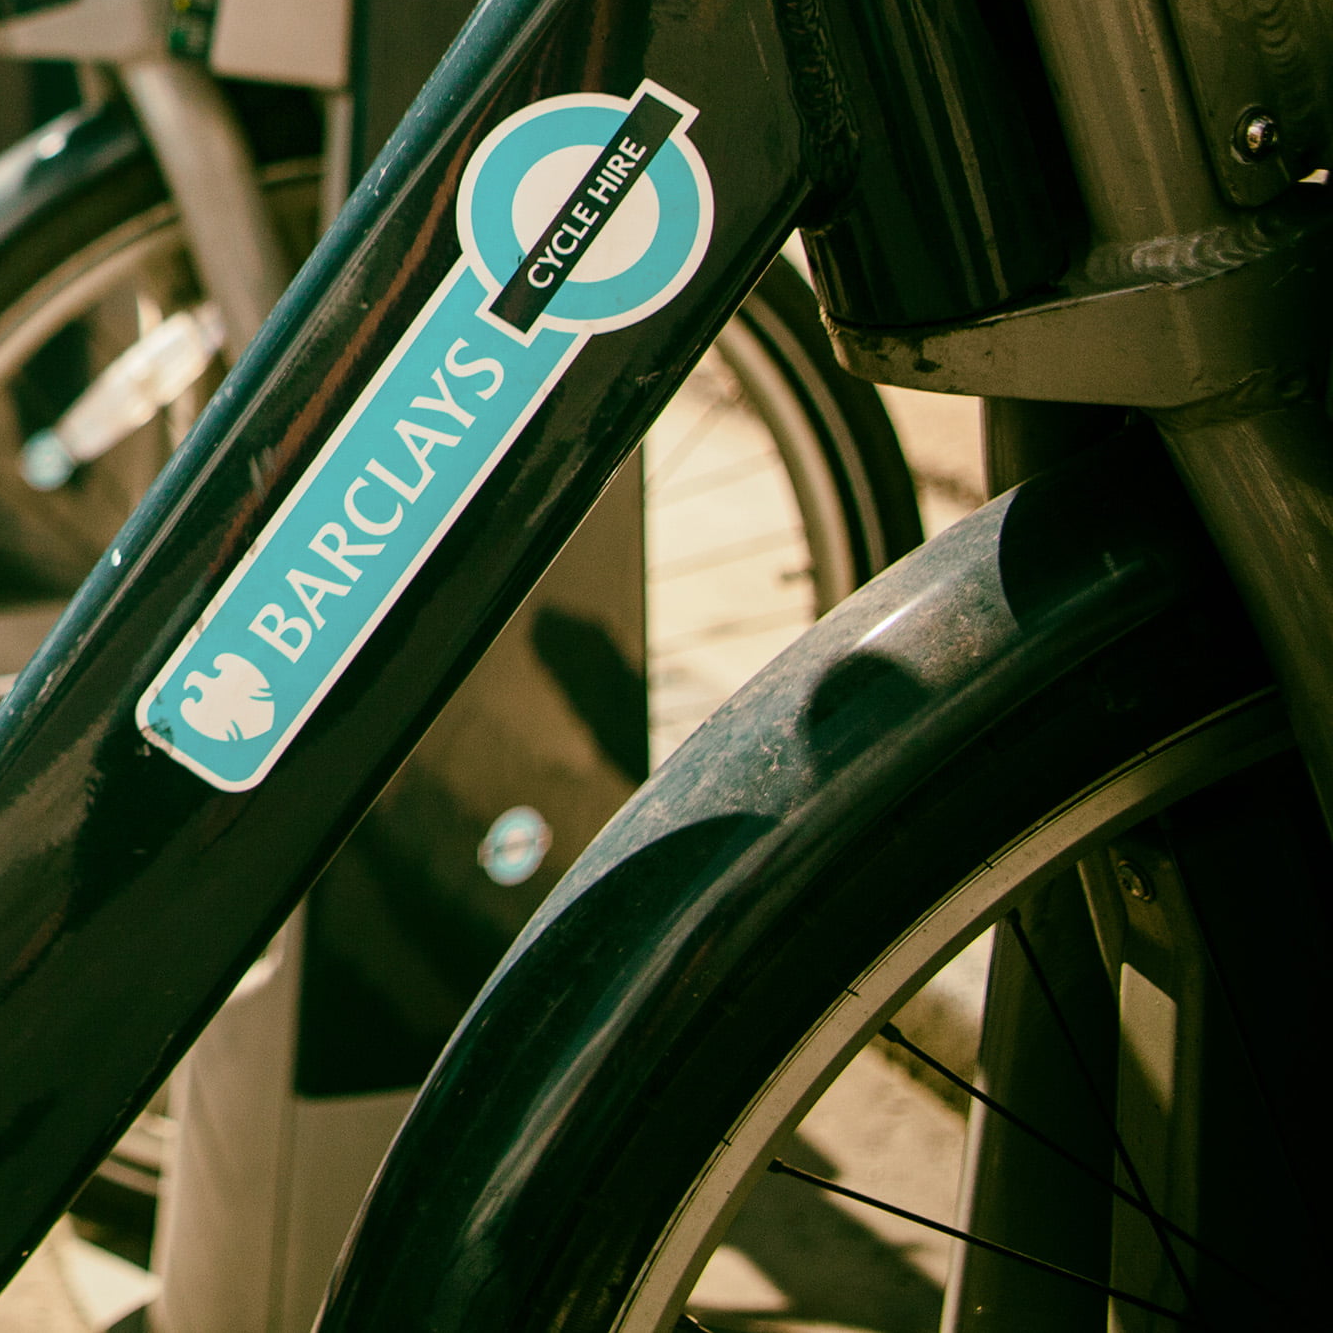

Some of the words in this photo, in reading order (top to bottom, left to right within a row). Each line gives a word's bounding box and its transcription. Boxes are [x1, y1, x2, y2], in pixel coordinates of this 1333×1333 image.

[527, 201, 600, 289] CYCLE
[587, 136, 647, 205] HIRE
[247, 337, 505, 664] BARCLAYS
